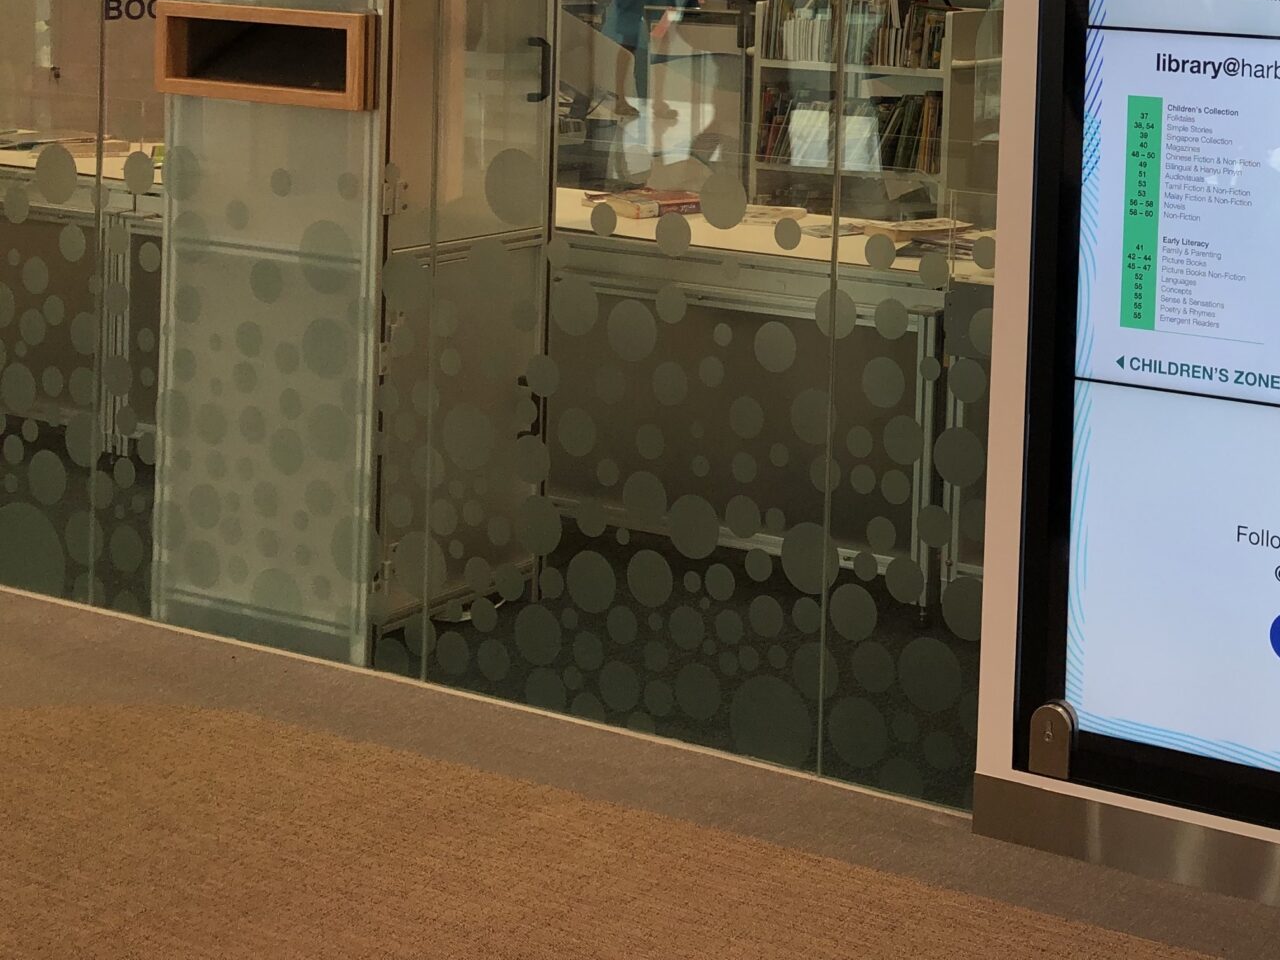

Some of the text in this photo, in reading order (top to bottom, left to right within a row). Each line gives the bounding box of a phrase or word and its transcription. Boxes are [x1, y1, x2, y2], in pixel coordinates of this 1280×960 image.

[1167, 104, 1239, 116] Children's Collection
[1163, 237, 1209, 248] Early Literacy
[1129, 357, 1280, 390] CHILDREN'S ZONE
